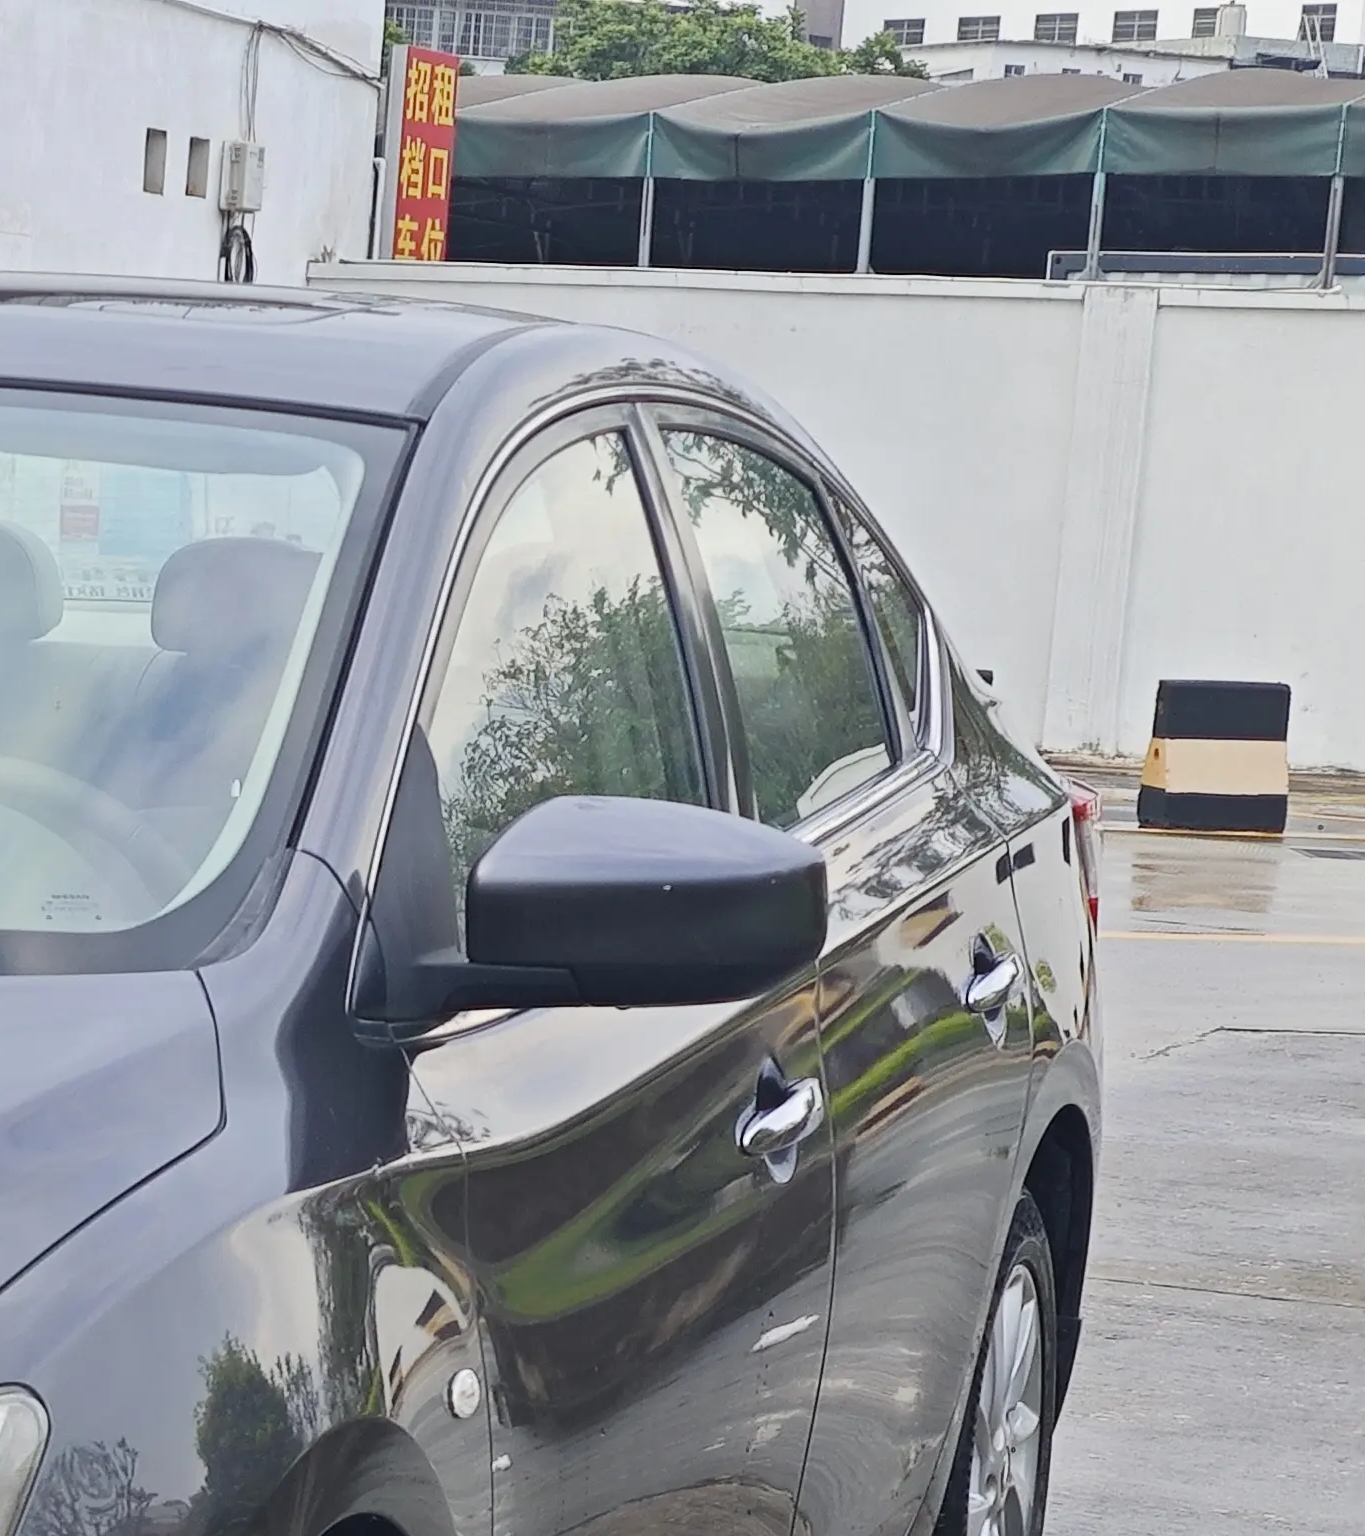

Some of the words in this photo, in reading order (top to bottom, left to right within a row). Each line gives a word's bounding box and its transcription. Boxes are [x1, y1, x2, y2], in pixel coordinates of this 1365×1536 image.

[405, 57, 456, 126] 招租
[400, 135, 448, 200] 档口
[394, 212, 445, 261] 车位
